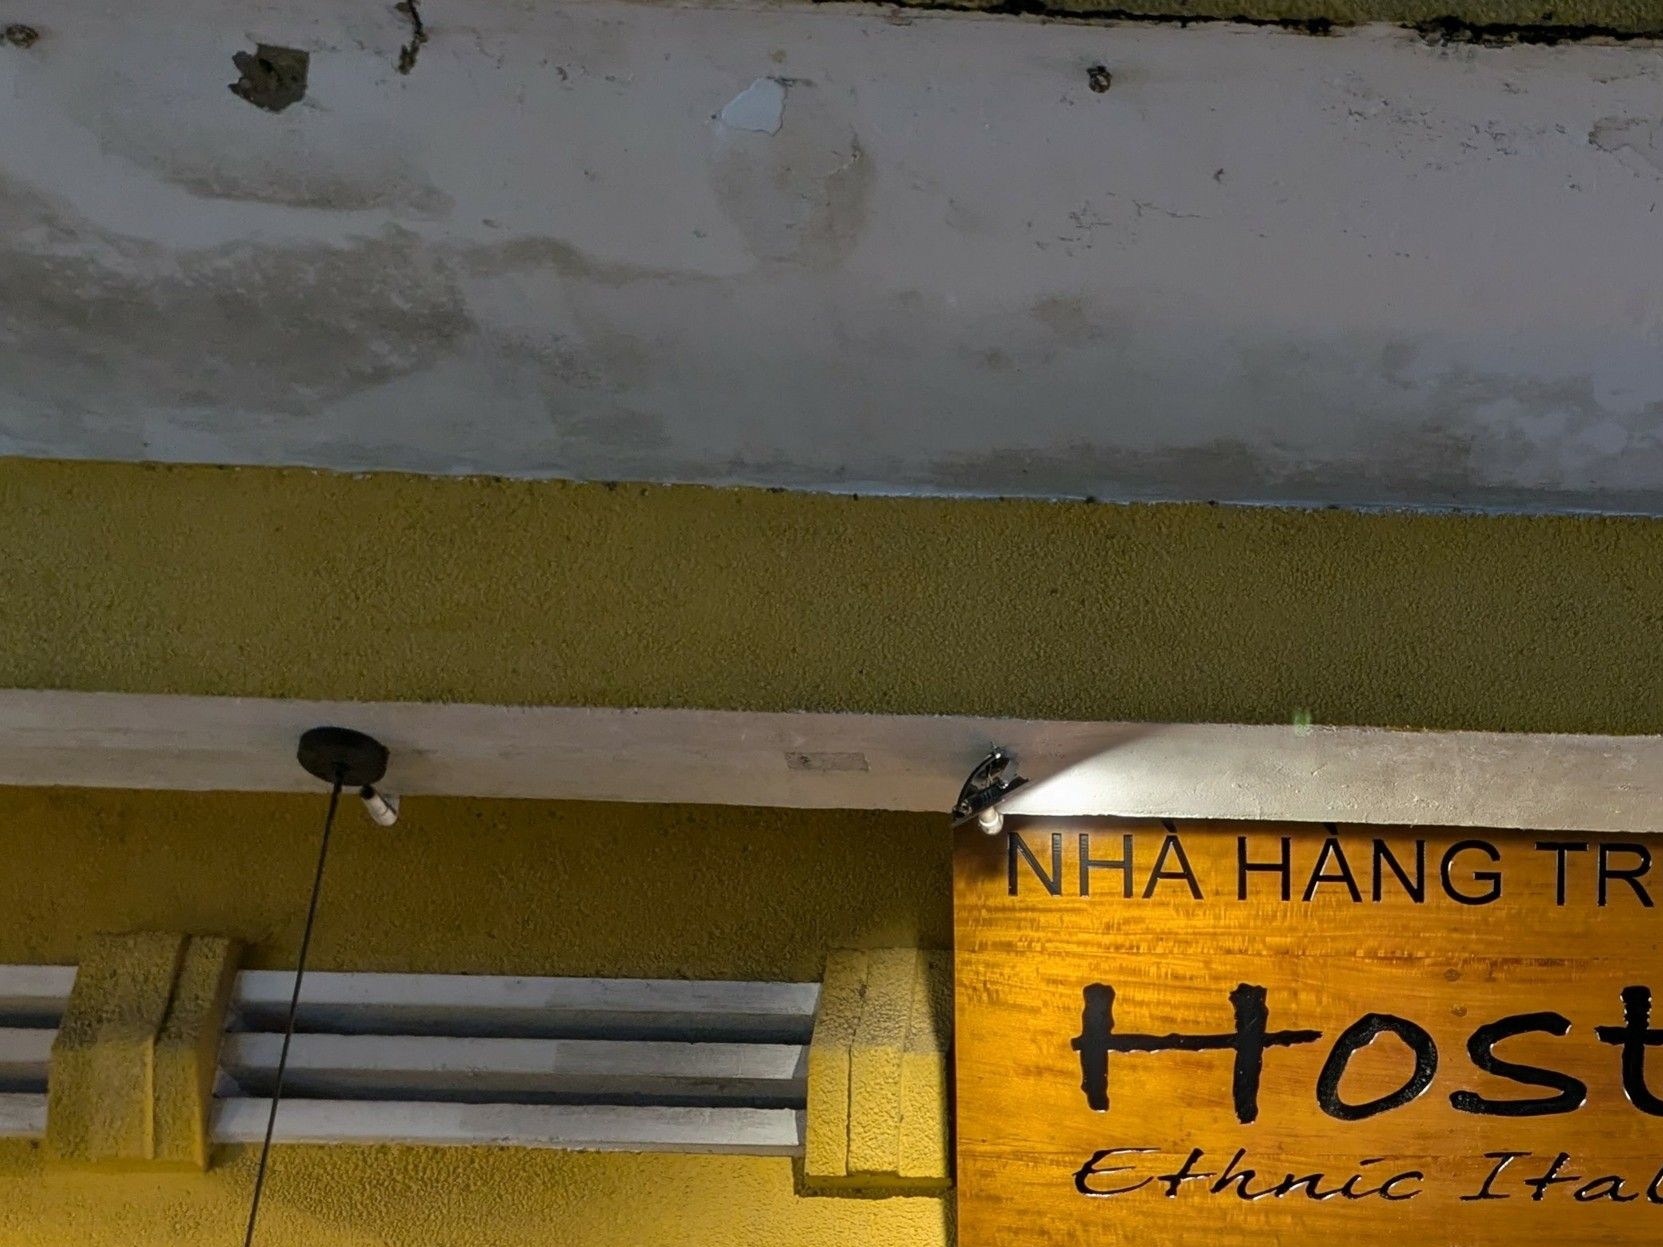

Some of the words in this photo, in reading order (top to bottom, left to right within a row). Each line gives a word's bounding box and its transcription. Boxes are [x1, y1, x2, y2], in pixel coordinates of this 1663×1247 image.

[1006, 817, 1204, 899] NHÀ
[1236, 822, 1503, 907] HÀNG
[1073, 1147, 1426, 1202] Ethnic
